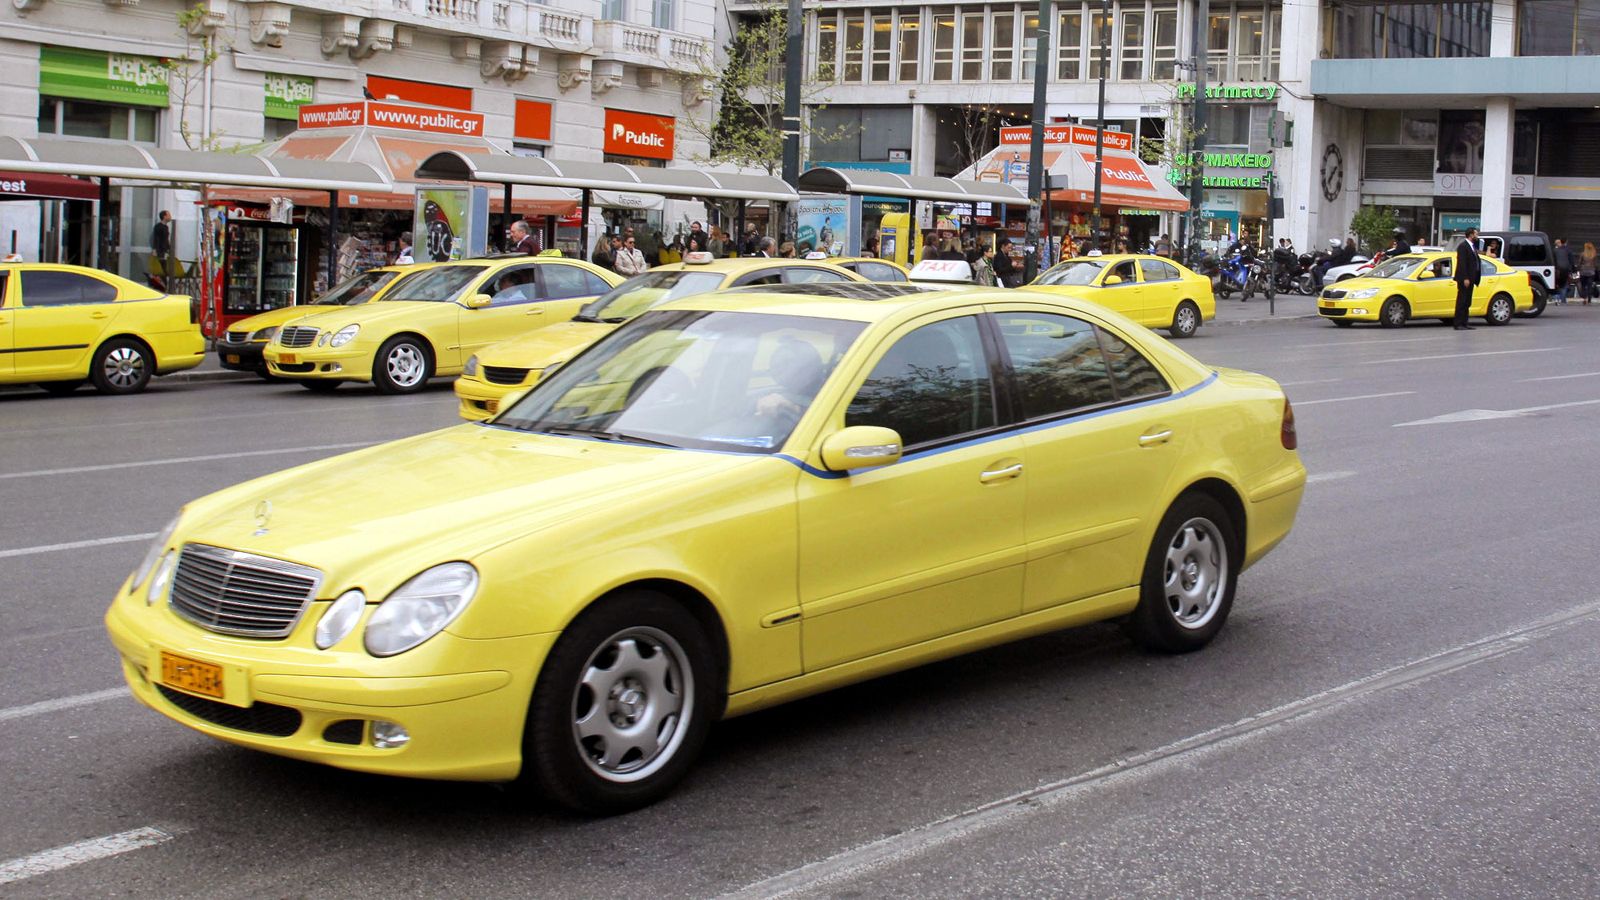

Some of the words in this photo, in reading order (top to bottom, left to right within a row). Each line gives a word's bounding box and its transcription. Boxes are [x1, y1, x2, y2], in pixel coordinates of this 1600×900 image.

[302, 107, 362, 126] www.public.gr
[373, 109, 479, 135] www.public.gr
[625, 130, 665, 148] Public
[1103, 167, 1149, 183] Public
[1440, 174, 1477, 190] CITY
[919, 261, 958, 272] TAXI
